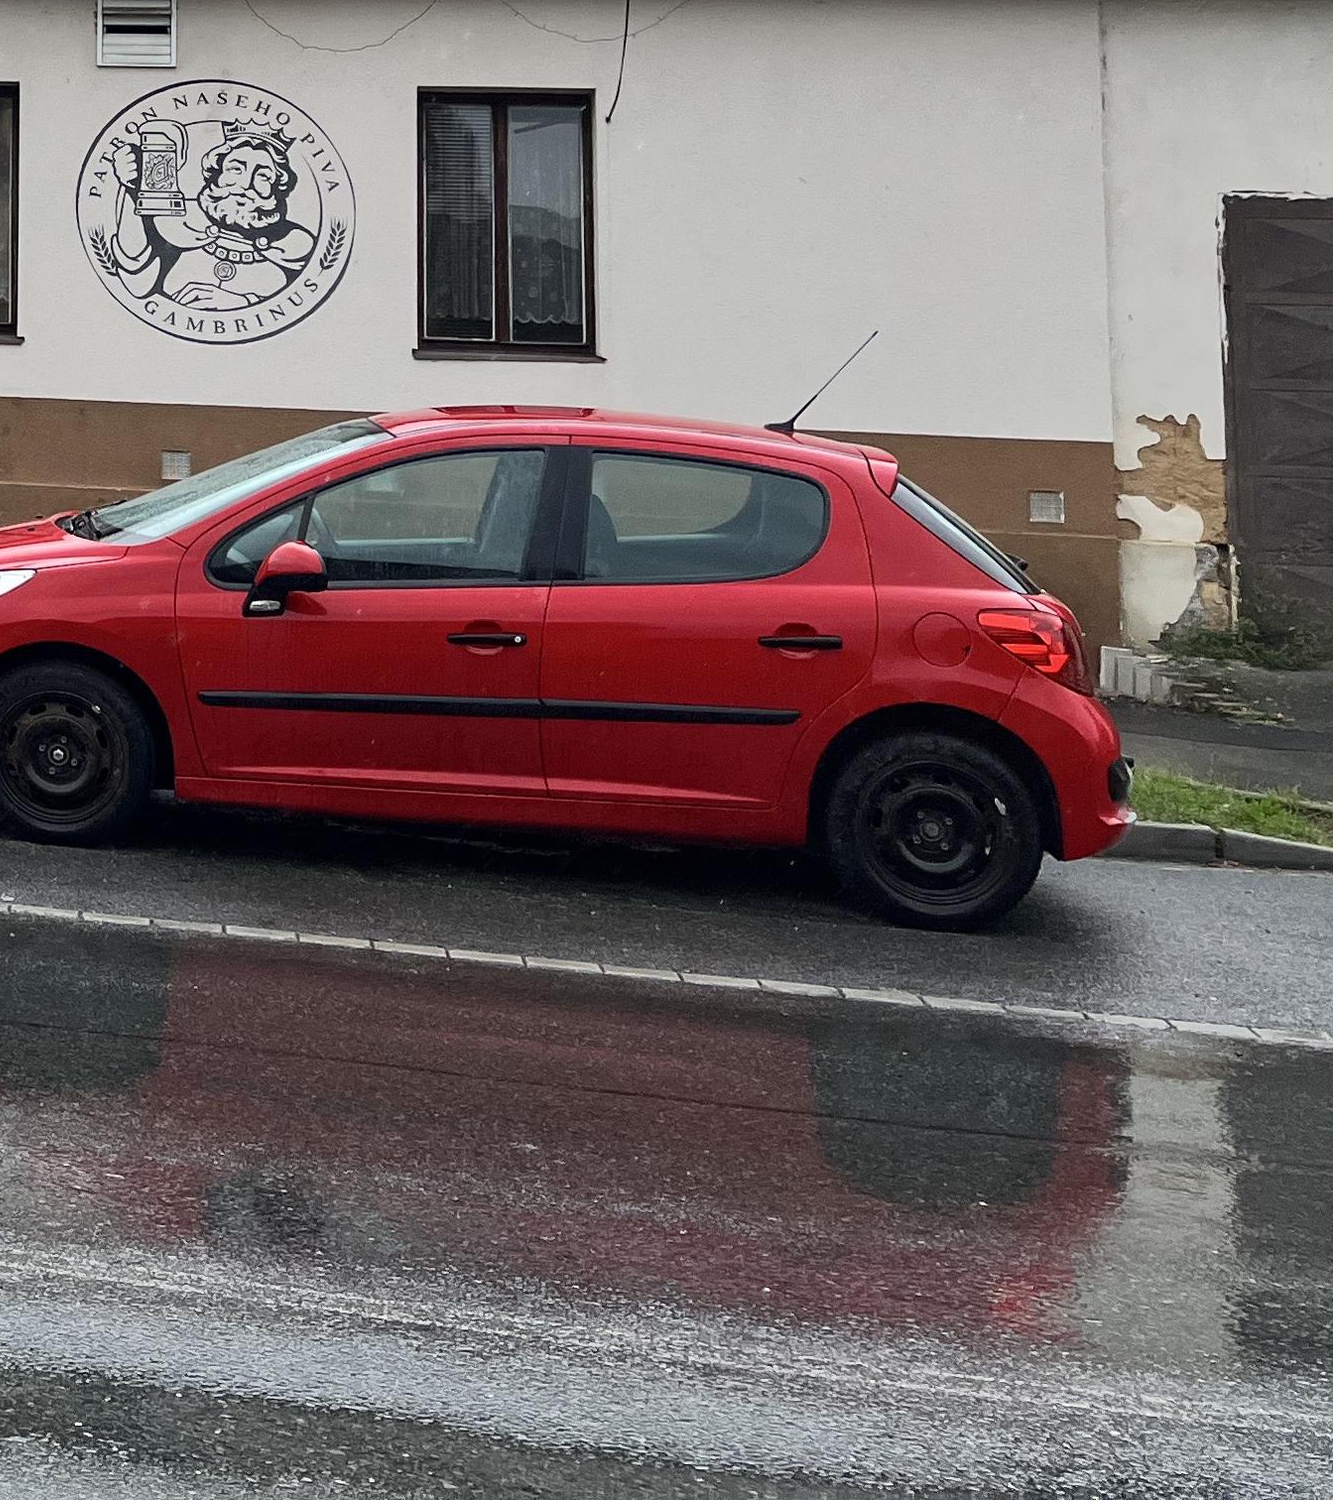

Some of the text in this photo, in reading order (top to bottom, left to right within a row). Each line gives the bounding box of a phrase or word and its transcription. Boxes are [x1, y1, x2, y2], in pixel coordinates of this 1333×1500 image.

[89, 89, 340, 199] PATRON NAŠEHO PIVA
[144, 278, 319, 334] GAMBRINUS
